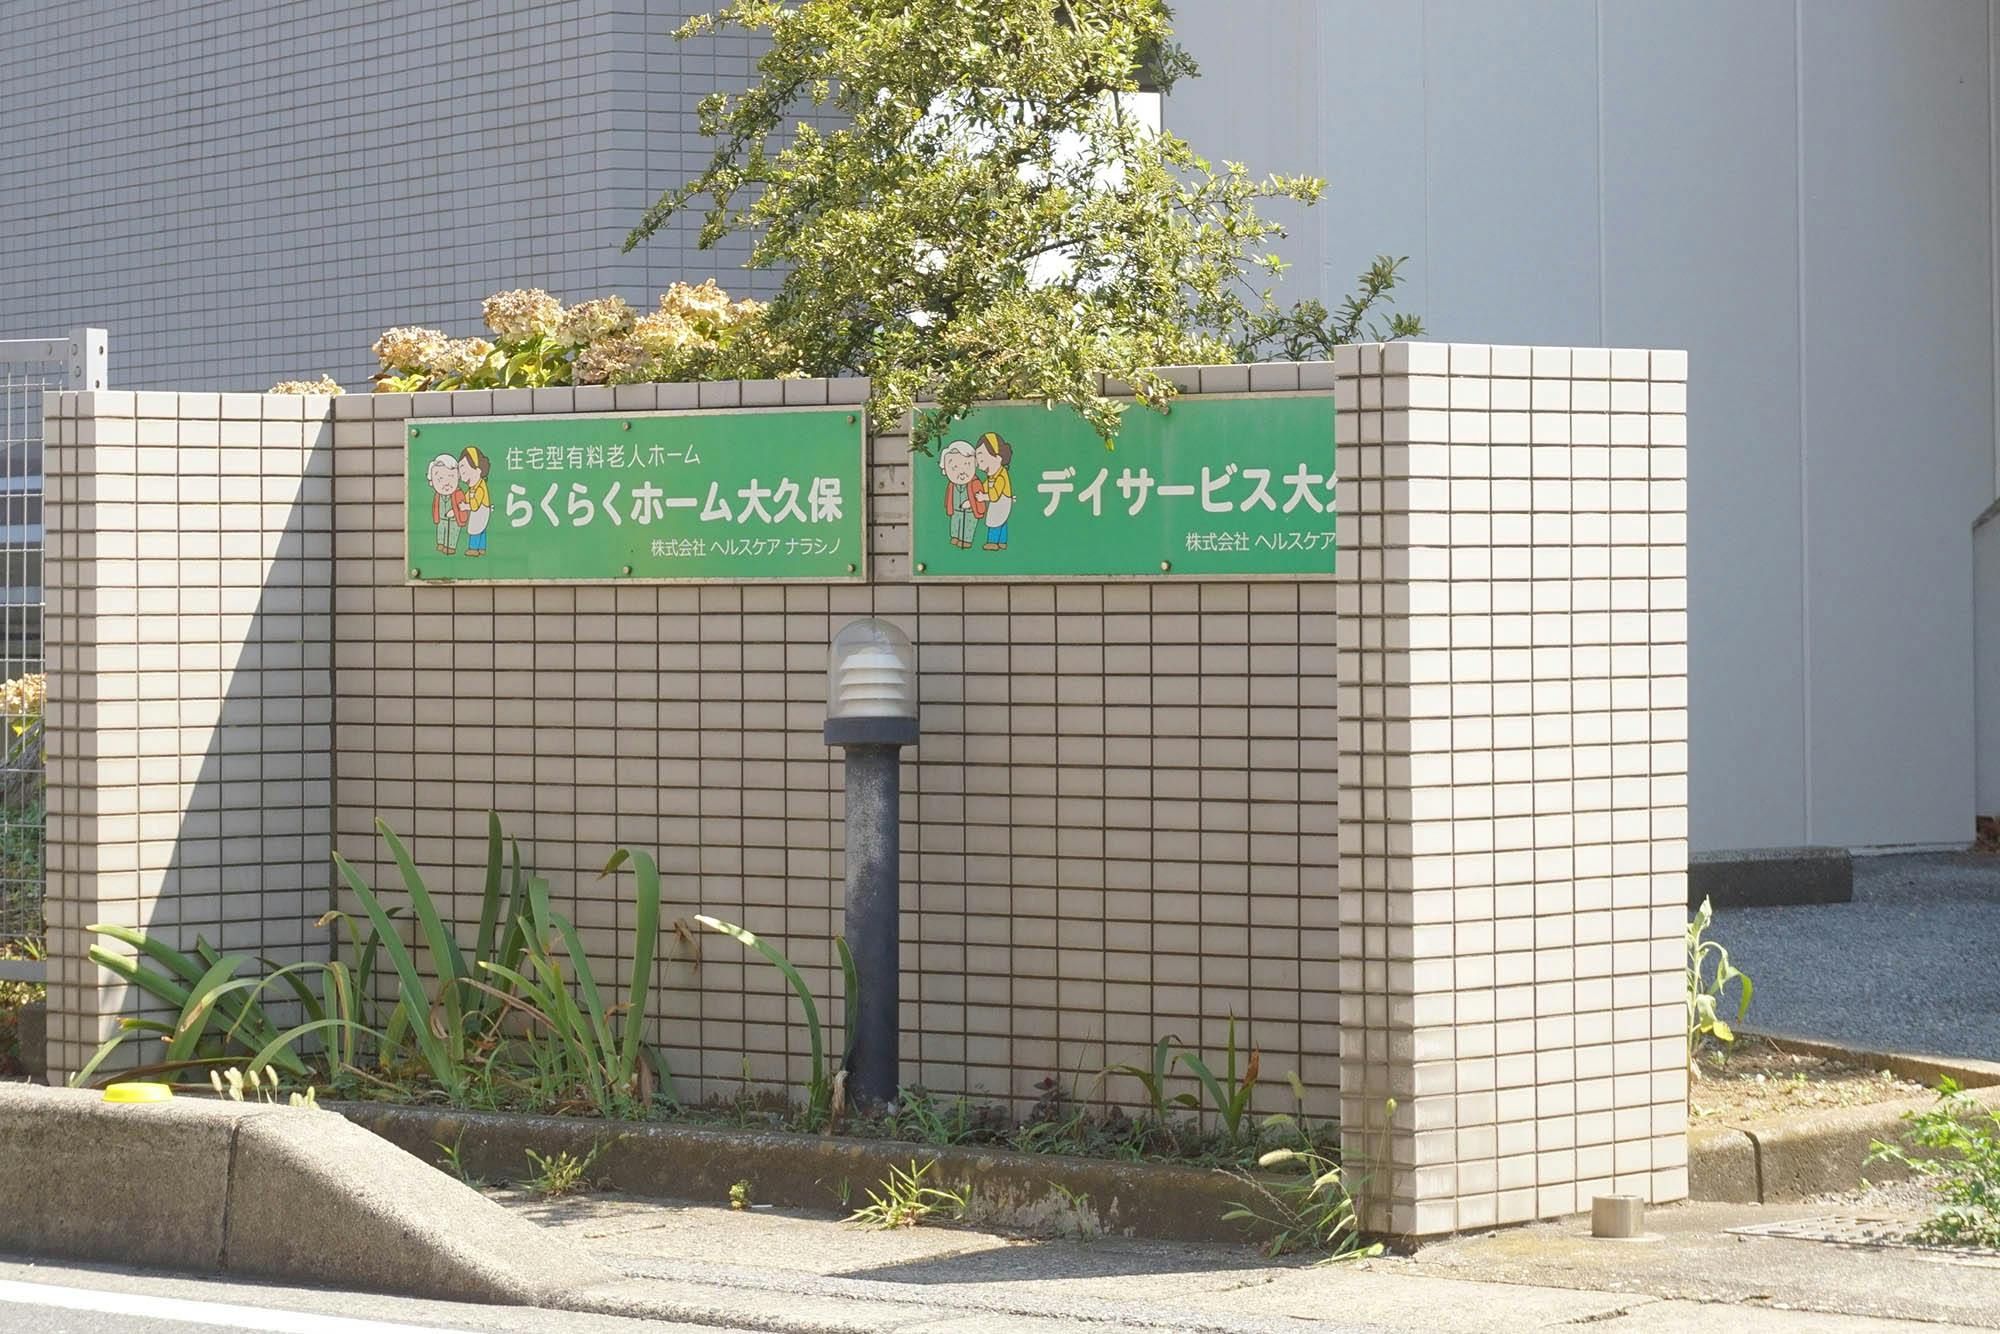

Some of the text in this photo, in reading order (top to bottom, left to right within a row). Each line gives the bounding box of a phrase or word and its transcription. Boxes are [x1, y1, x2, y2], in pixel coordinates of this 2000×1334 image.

[506, 443, 701, 471] 住宅型有料老人ホーム
[506, 476, 844, 528] らくらくホーム大久保
[1037, 462, 1336, 517] デイサービス大
[651, 537, 840, 557] 株式会社 ヘルスケア ナラシノ
[1185, 531, 1336, 553] 株式会社 ヘルスケア
